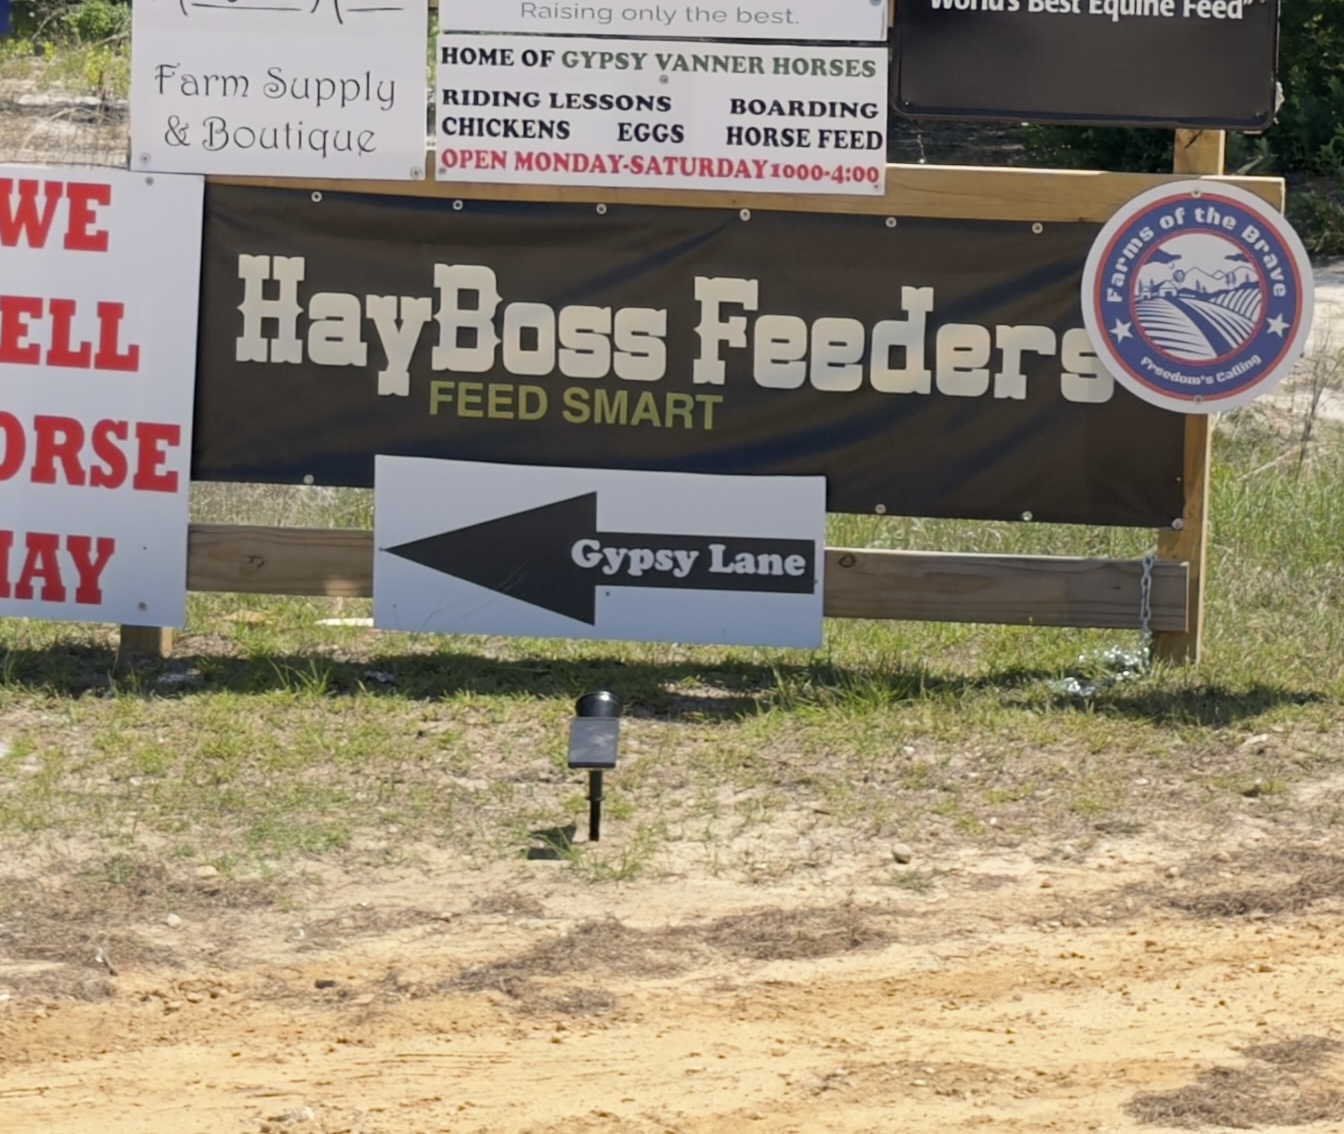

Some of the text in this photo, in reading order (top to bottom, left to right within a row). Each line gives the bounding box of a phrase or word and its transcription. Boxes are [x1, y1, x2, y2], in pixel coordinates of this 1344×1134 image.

[520, 2, 799, 26] Raising only the best.
[441, 47, 876, 78] HOME OF GYPSY VANNER HORSES
[154, 63, 396, 111] Farm Supply
[441, 89, 879, 119] RIDING LESSONS BOARDING
[164, 114, 377, 158] & Boutique
[441, 117, 883, 151] CHICKENS EGGS HORSE FEED
[441, 149, 508, 170] OPEN
[1106, 207, 1287, 303] Farms of the Brave
[235, 254, 1114, 404] HayBoss Feeders
[1140, 354, 1262, 385] Freedom's Calling
[429, 380, 724, 431] FEED SMART
[571, 538, 806, 578] Gypsy Lane
